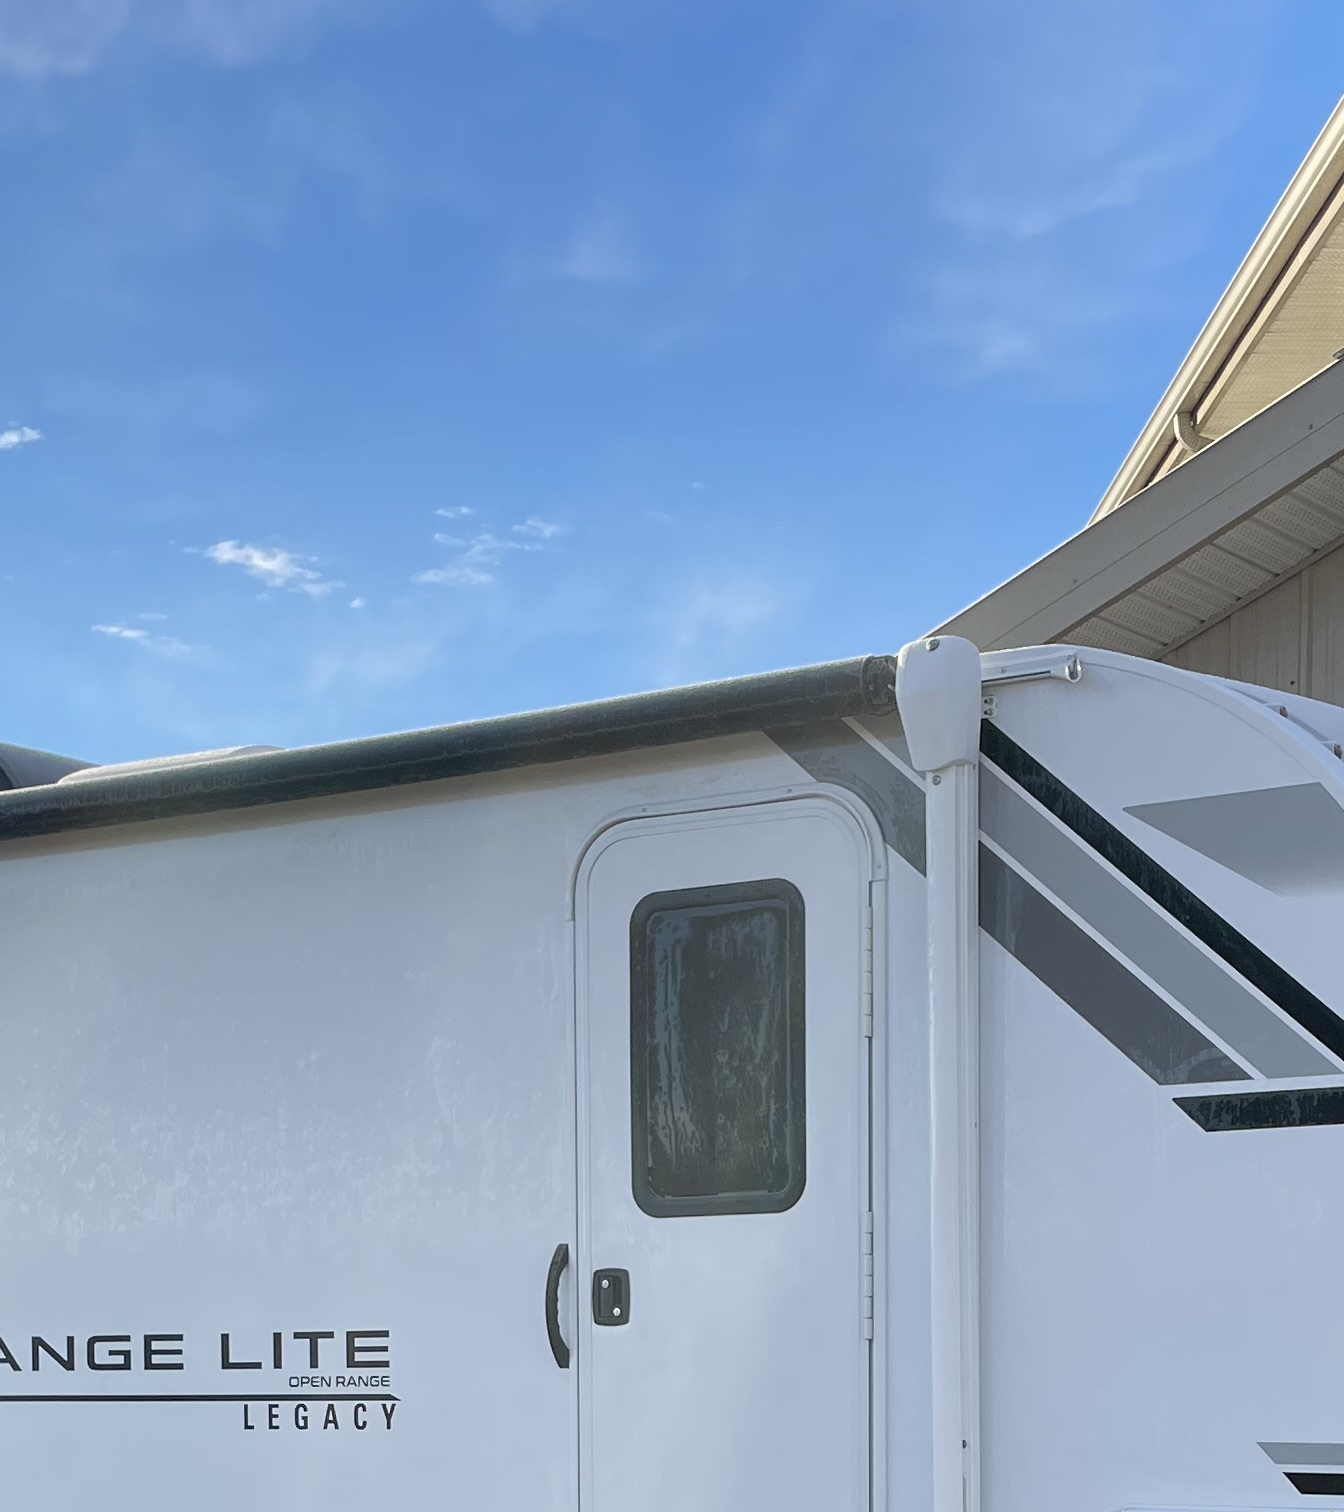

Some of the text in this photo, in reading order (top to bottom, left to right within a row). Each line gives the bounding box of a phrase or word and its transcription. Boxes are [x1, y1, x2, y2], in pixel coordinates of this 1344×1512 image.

[220, 1329, 390, 1371] LITE
[288, 1375, 391, 1389] OPEN RANGE
[243, 1402, 397, 1431] LEGACY
